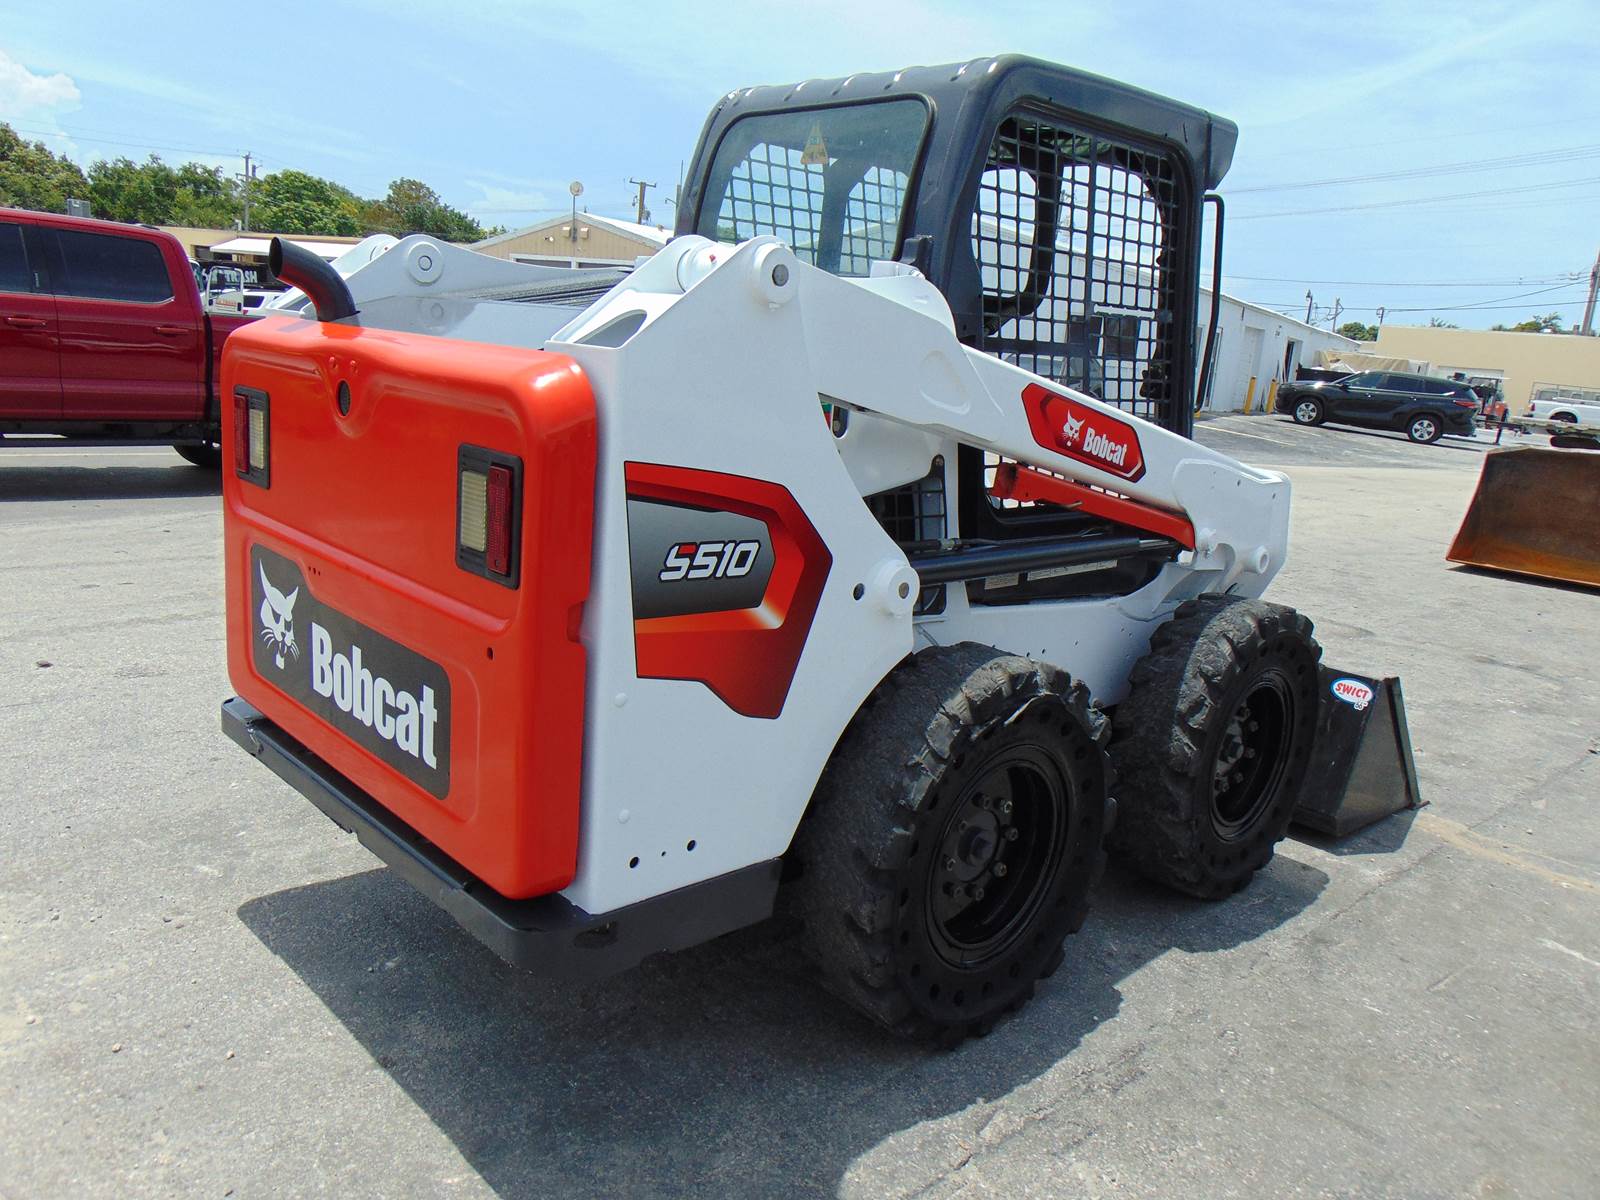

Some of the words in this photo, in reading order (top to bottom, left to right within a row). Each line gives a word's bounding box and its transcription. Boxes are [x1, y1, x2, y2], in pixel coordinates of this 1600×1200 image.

[1083, 427, 1127, 467] Bobcat
[659, 541, 760, 581] S510
[311, 621, 437, 770] Bobcat
[1335, 682, 1369, 700] SWICT
